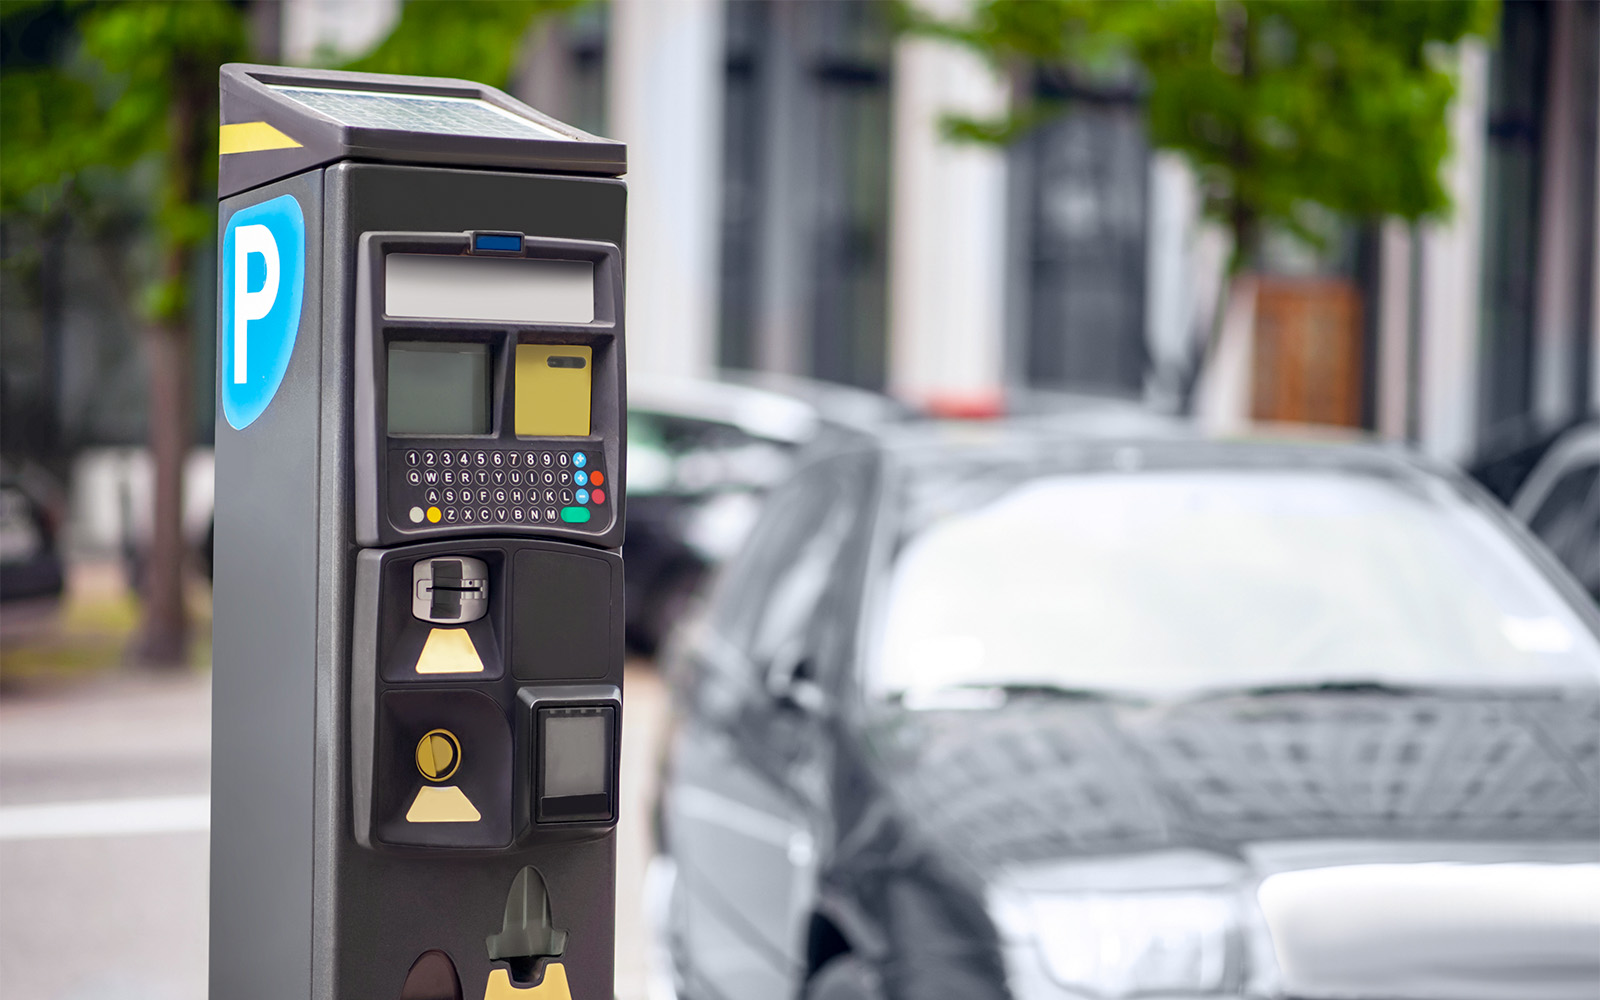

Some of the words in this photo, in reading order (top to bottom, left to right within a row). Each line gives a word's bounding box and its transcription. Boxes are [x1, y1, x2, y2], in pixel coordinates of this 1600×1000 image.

[234, 224, 280, 384] P
[409, 452, 416, 464] 1
[426, 452, 434, 465] 2
[443, 452, 451, 465] 3
[460, 453, 468, 465] 4
[477, 453, 485, 465] 5
[493, 453, 502, 465] 6
[510, 453, 518, 465] 7
[526, 453, 535, 466] 8
[543, 453, 551, 466] 9
[559, 454, 567, 466] 0
[409, 472, 419, 483] Q
[425, 472, 437, 483] W
[444, 472, 453, 483] E
[461, 472, 470, 483] R
[478, 472, 486, 483] T
[494, 472, 503, 483] Y
[511, 473, 520, 483] U
[530, 473, 534, 483] I
[544, 473, 553, 483] O
[561, 473, 569, 483] P
[428, 491, 438, 501] A
[446, 491, 454, 501] S
[462, 491, 471, 501] D
[480, 491, 487, 501] F
[496, 491, 505, 501] G
[513, 491, 521, 501] H
[530, 491, 537, 501] J
[546, 491, 554, 502] K
[562, 491, 570, 502] L
[447, 509, 455, 520] Z
[464, 509, 472, 520] X
[480, 509, 489, 520] C
[497, 509, 506, 520] V
[514, 509, 523, 520] B
[530, 509, 539, 520] N
[546, 509, 556, 520] M
